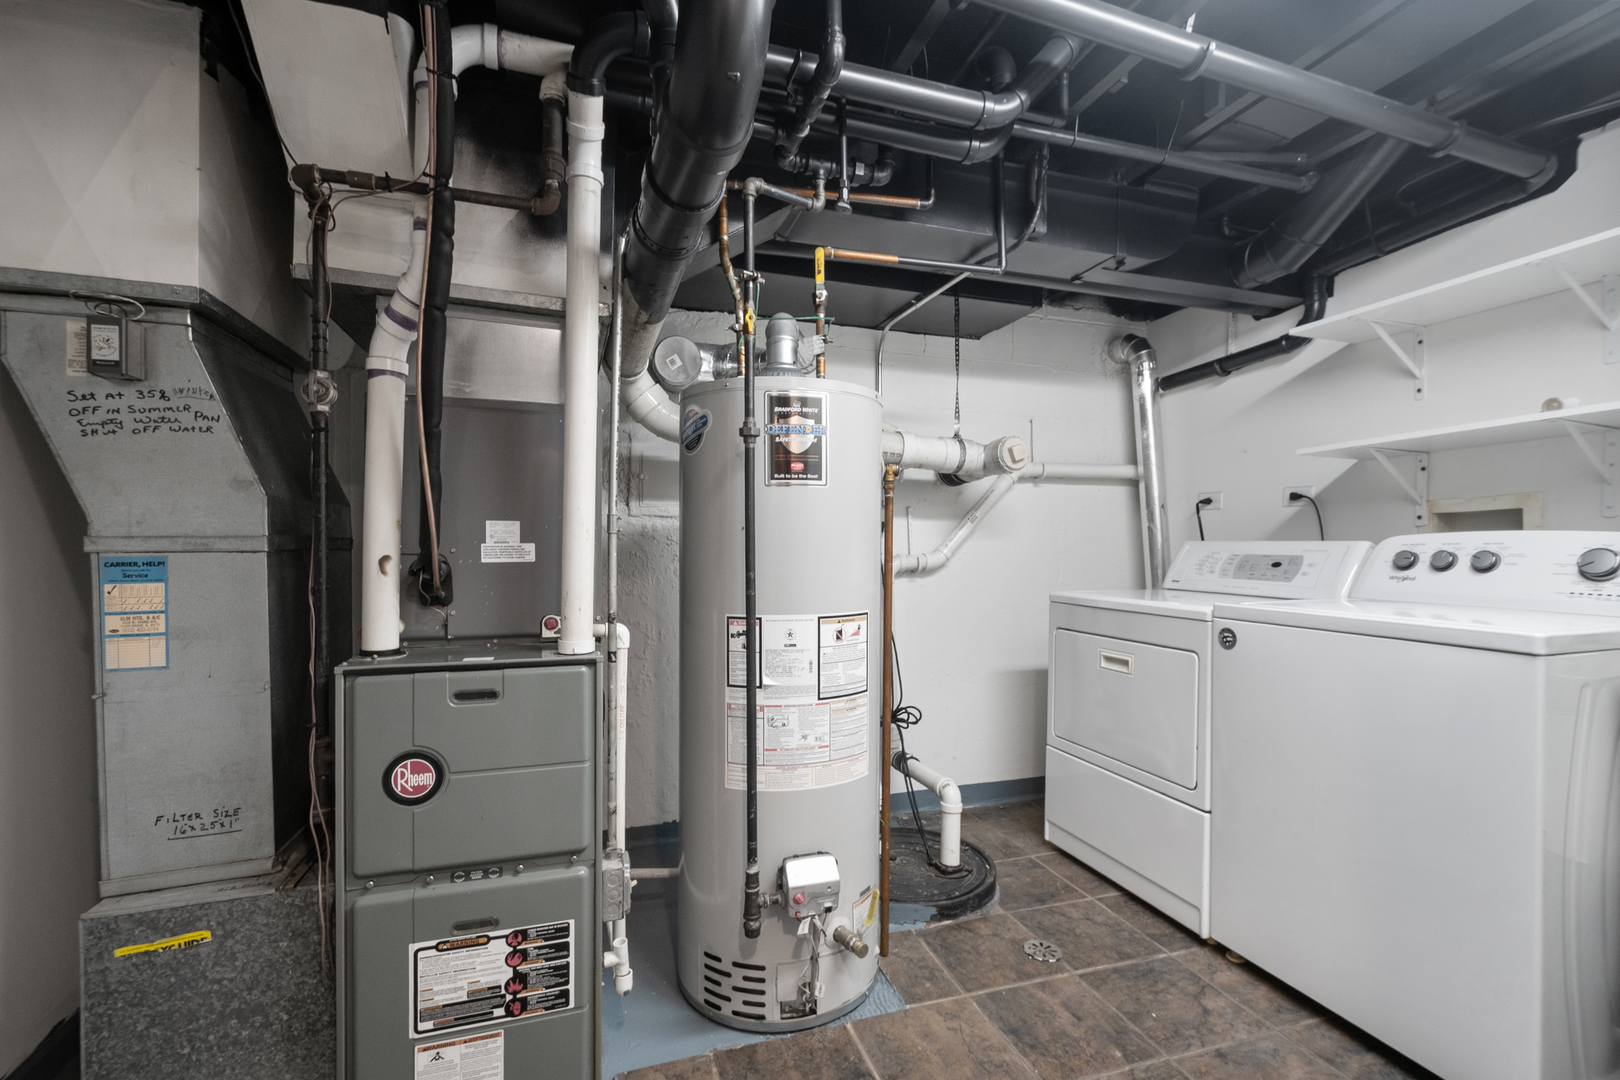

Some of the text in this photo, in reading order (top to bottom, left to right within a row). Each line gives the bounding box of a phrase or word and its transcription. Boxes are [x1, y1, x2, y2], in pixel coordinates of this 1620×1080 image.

[69, 406, 101, 416] OFF
[194, 411, 220, 423] PAN
[132, 425, 162, 434] OFF
[766, 424, 826, 435] DEFENDER
[1389, 574, 1416, 583] Whirlpool
[398, 760, 432, 792] Rheem
[154, 812, 203, 826] FILTER
[450, 939, 480, 947] WARNING
[426, 1041, 456, 1051] WARNING
